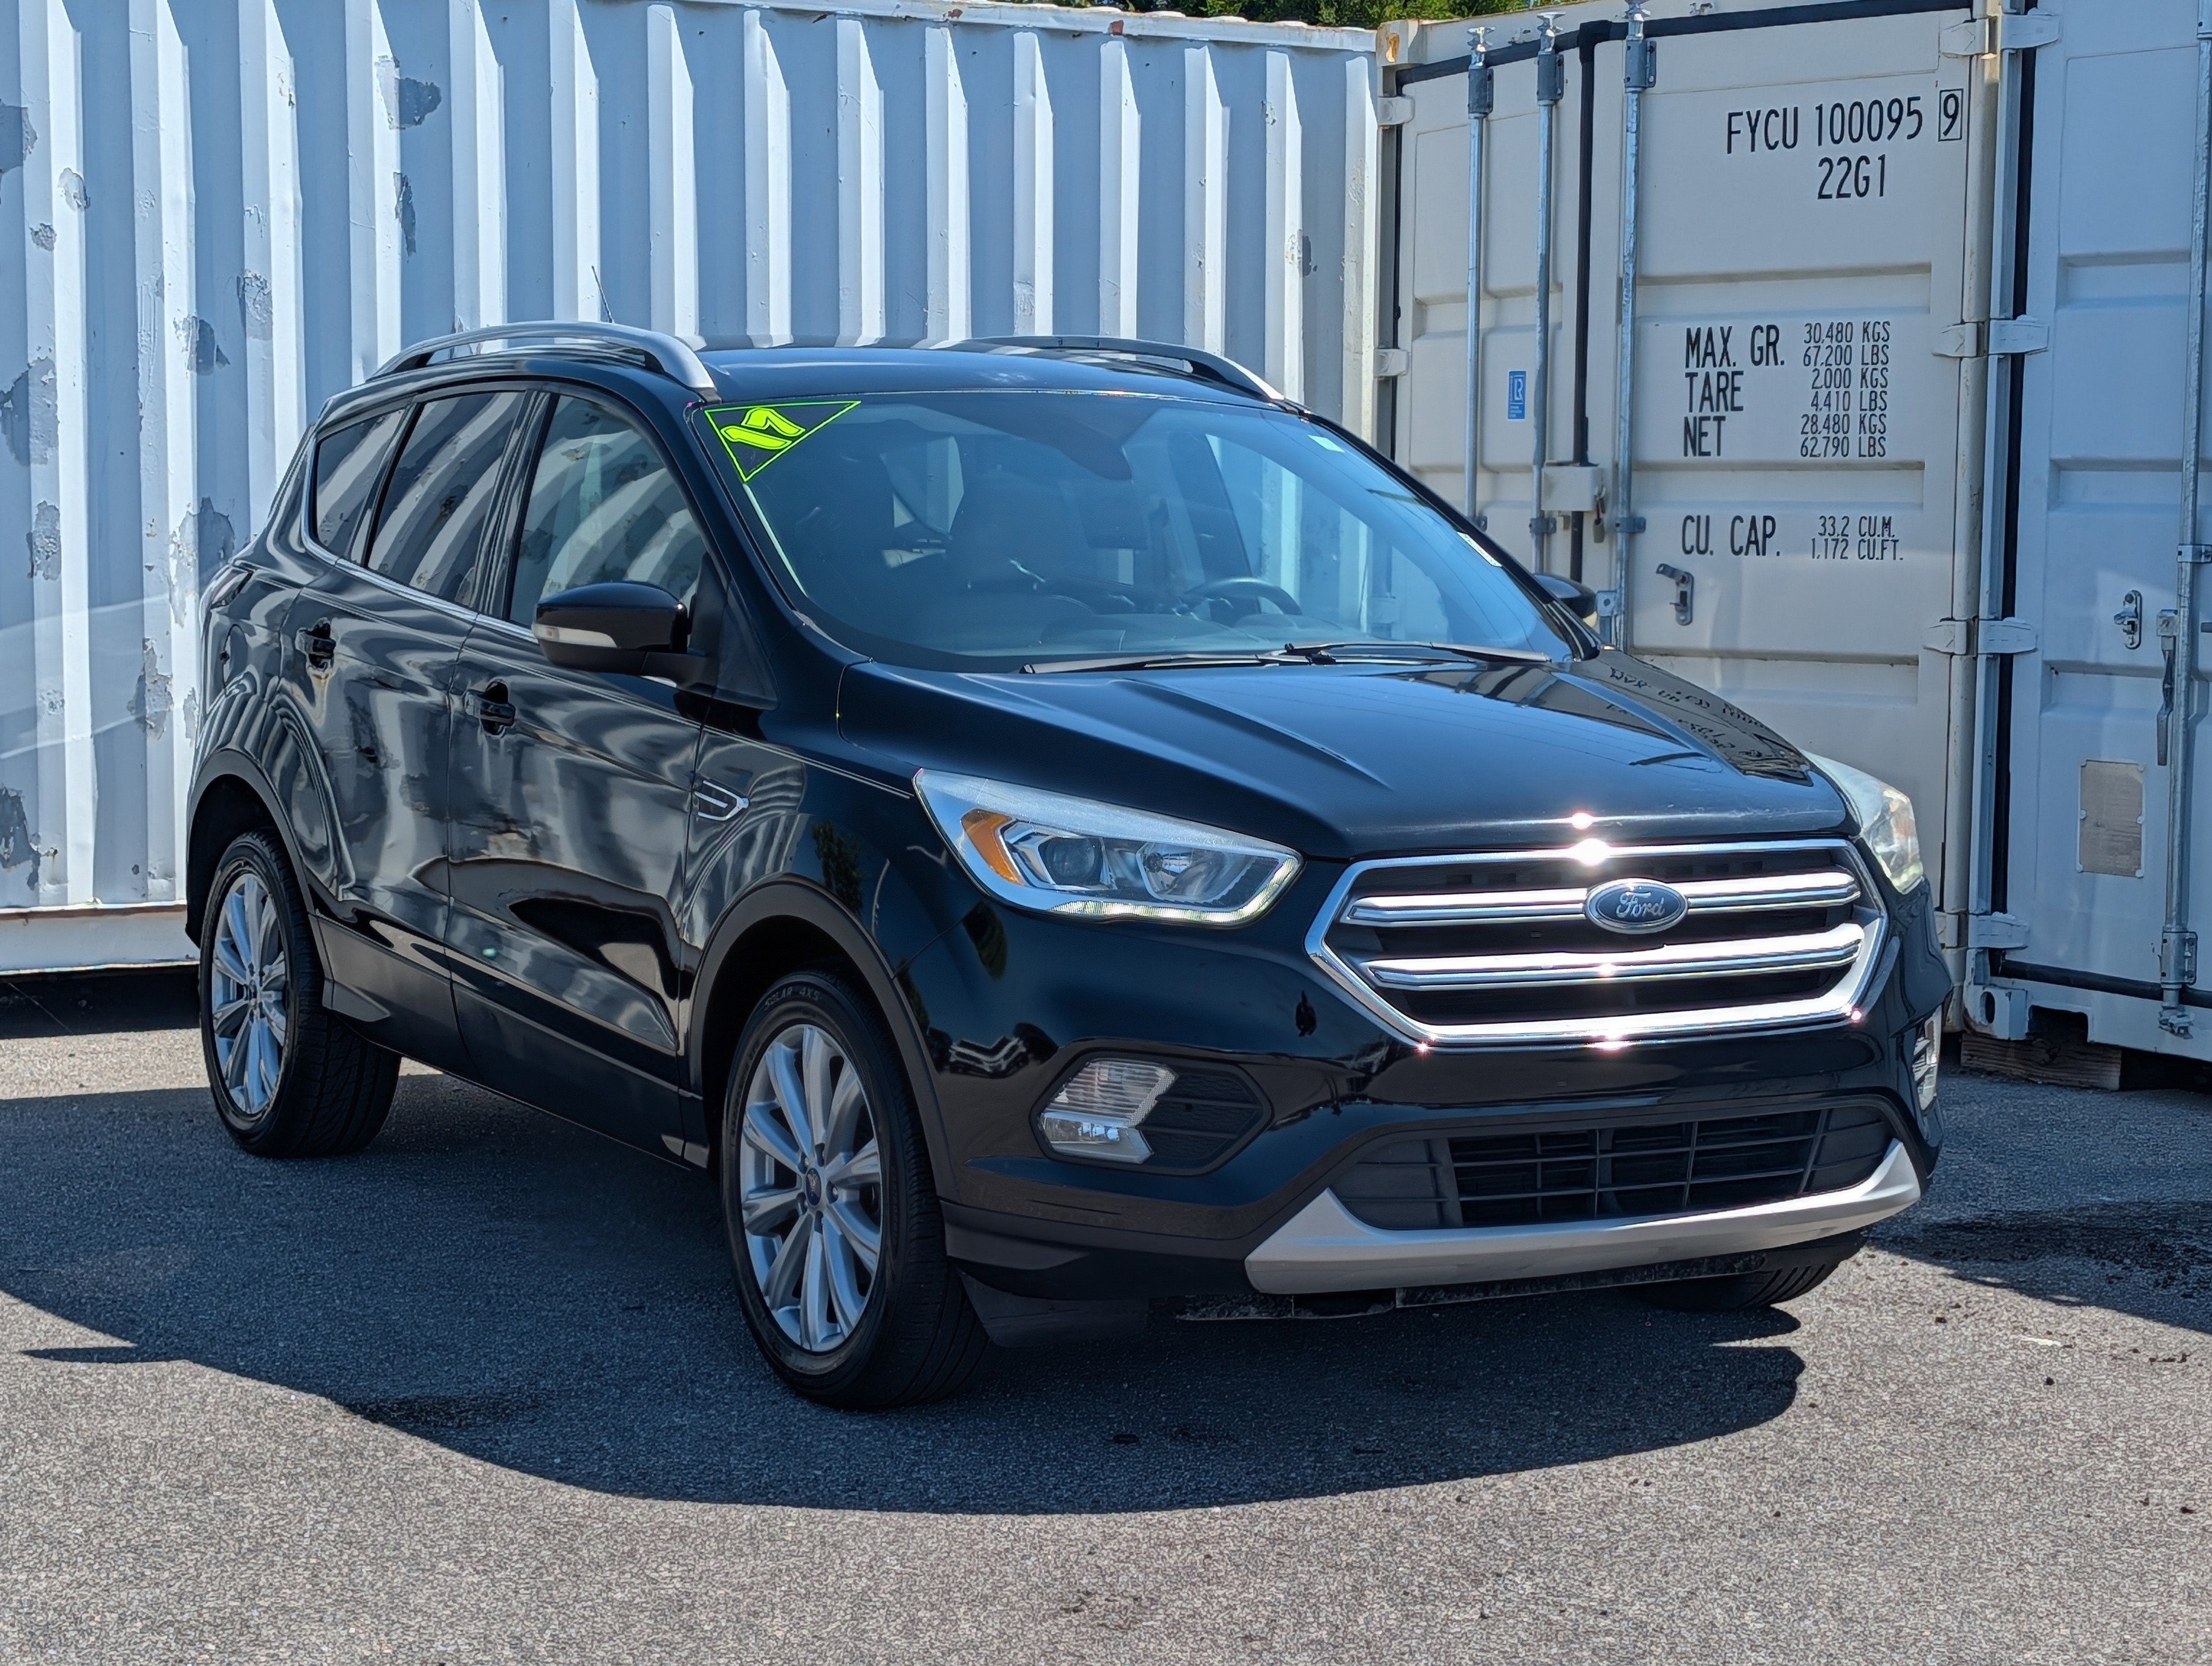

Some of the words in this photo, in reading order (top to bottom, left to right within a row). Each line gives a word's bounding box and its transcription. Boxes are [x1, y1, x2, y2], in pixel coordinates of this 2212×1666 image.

[1726, 106, 1799, 154] FYCU
[1815, 96, 1922, 146] 100095
[1942, 93, 1959, 137] 9
[1817, 153, 1886, 200] 22G1
[1862, 321, 1891, 343] KGS
[1685, 325, 1737, 369] MAX.
[1750, 324, 1785, 367] GR.
[1861, 344, 1889, 366] LBS
[1860, 367, 1889, 389] KGS
[1684, 370, 1744, 413] TARE
[1859, 390, 1888, 412] LBS
[1859, 413, 1887, 435] KGS
[1683, 415, 1726, 457] NET
[1858, 435, 1886, 458] LBS
[1682, 515, 1714, 556] CU.
[1729, 515, 1780, 556] CAP.
[1818, 515, 1850, 537] 33.2
[1858, 515, 1896, 537] CU.M.
[1857, 538, 1904, 560] CU.FT.
[1616, 890, 1666, 918] Ford
